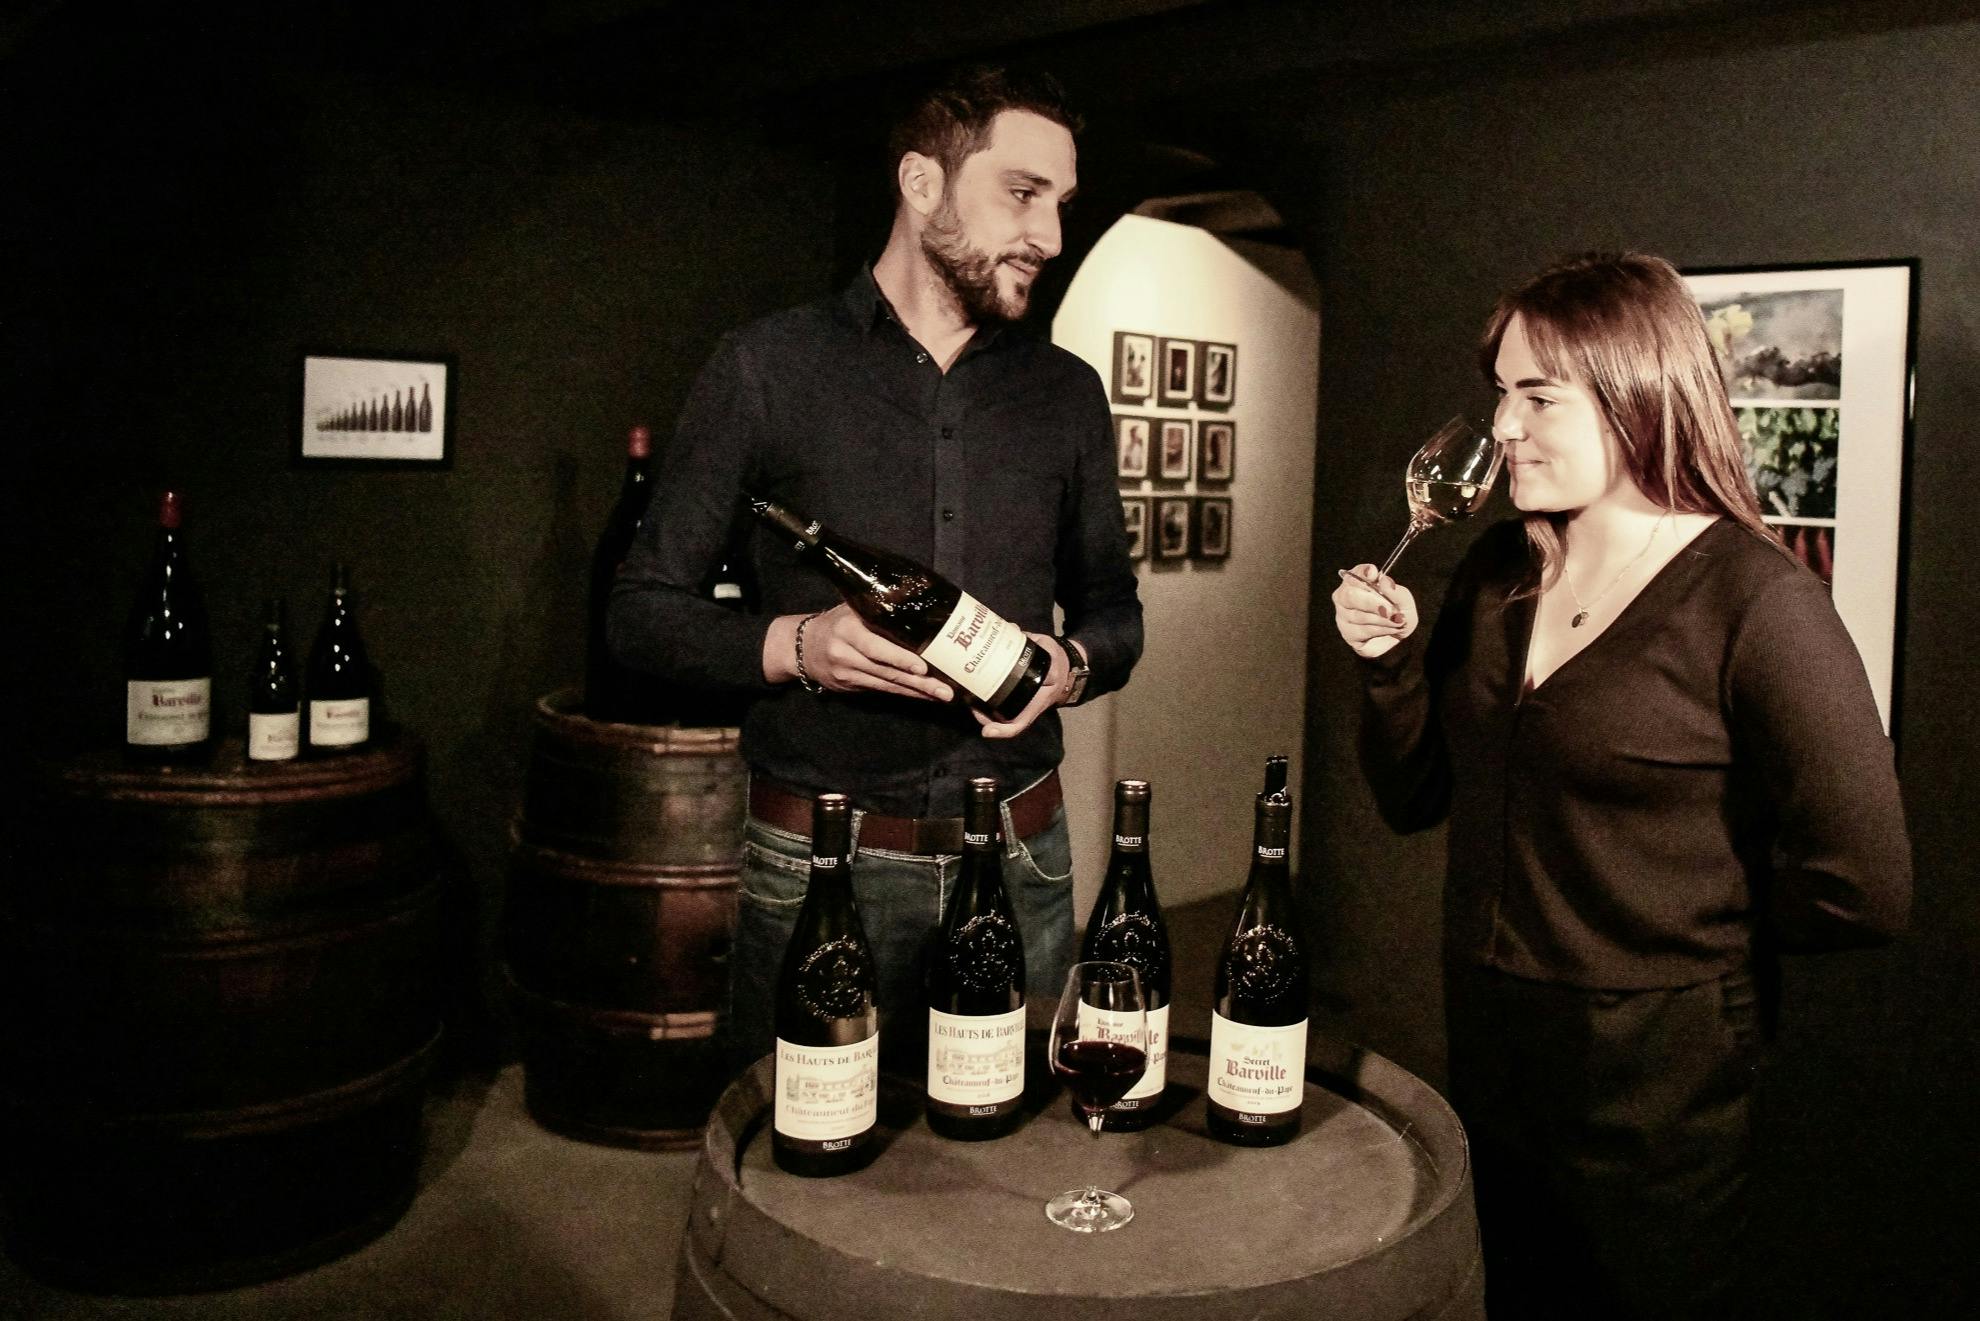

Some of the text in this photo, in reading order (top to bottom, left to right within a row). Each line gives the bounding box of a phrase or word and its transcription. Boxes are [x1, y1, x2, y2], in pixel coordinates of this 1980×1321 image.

[953, 603, 990, 651] Barvill
[964, 832, 989, 843] BROTTE
[1115, 834, 1142, 844] BROTTE
[1257, 846, 1286, 857] BROTTE
[812, 855, 838, 866] BROTTE
[935, 1021, 948, 1037] LES
[948, 1025, 980, 1040] HAUTS
[981, 1029, 994, 1040] DE
[796, 1053, 836, 1066] HAUTS
[837, 1056, 850, 1066] DE
[1243, 1056, 1271, 1066] Secret
[1226, 1058, 1287, 1081] Barville
[969, 1105, 998, 1115] BROTTE
[1238, 1112, 1267, 1123] BROTTE
[822, 1138, 852, 1150] BROTTE
